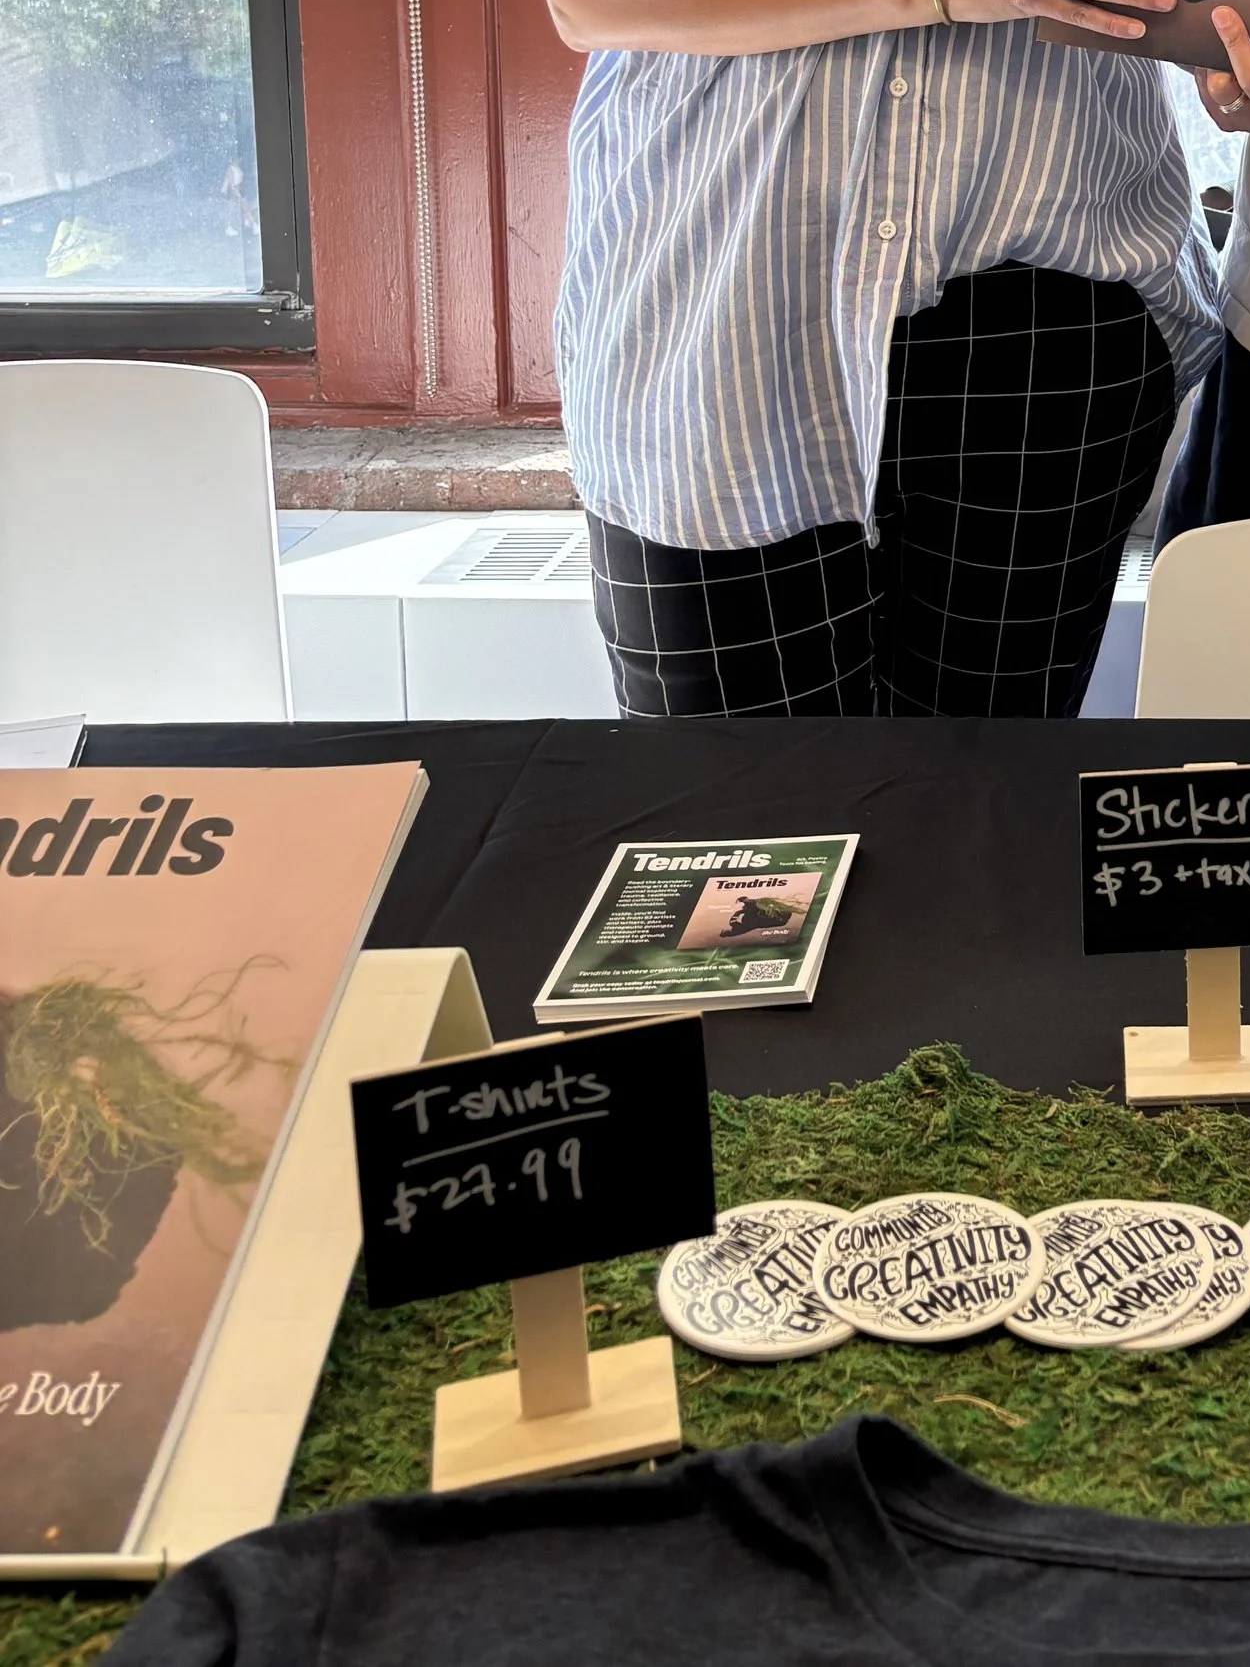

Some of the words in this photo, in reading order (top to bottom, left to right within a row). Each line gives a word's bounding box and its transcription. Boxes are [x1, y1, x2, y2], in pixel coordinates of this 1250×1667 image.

[633, 849, 772, 873] Tendrils
[716, 877, 788, 890] Tendrils
[1093, 861, 1163, 907] $3
[391, 1064, 611, 1134] T-shirts
[383, 1137, 583, 1234] $27.99
[672, 1219, 777, 1291] COMMUNITY
[835, 1203, 952, 1252] COMMUNITY
[823, 1224, 1032, 1302] CREATIVITY
[900, 1271, 1015, 1325] EMPATHY
[1094, 1262, 1197, 1327] EMPATHY
[14, 1370, 122, 1427] Body
